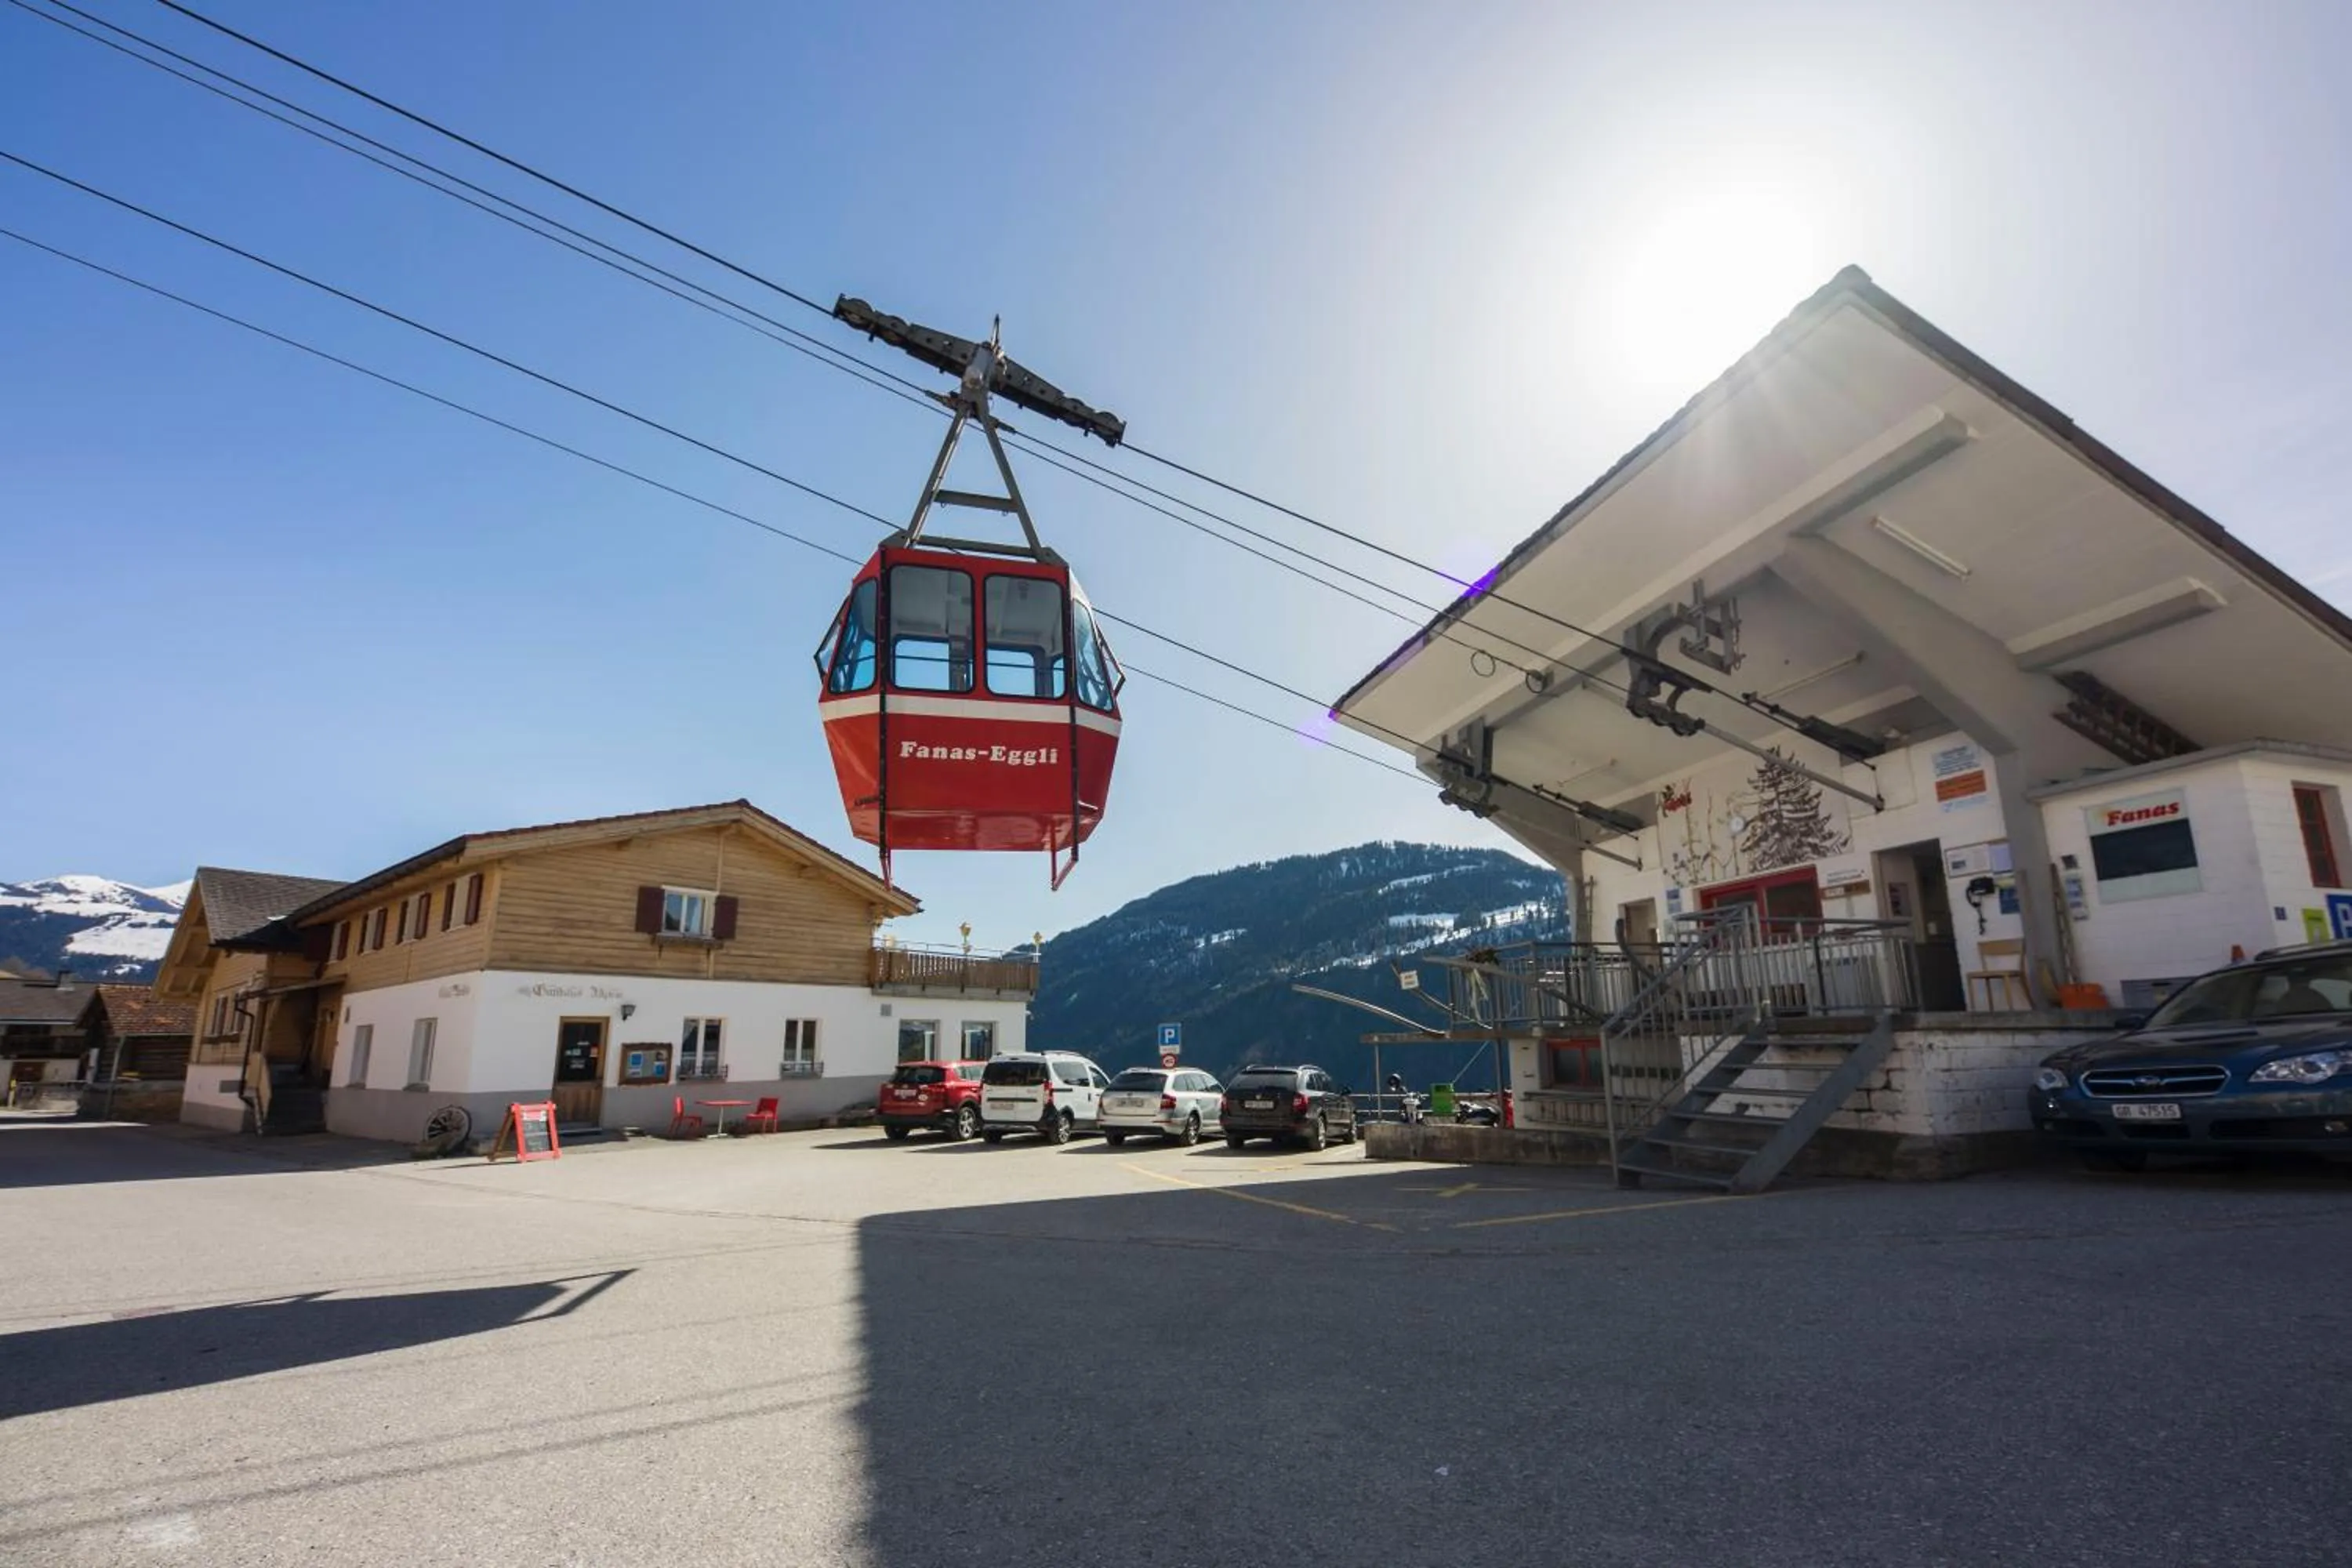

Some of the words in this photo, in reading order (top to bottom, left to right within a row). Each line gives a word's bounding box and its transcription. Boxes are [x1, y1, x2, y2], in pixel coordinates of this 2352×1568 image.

[900, 741, 1058, 766] Fanas-Eggli
[2107, 802, 2179, 826] Fanas
[1164, 1028, 1175, 1044] P
